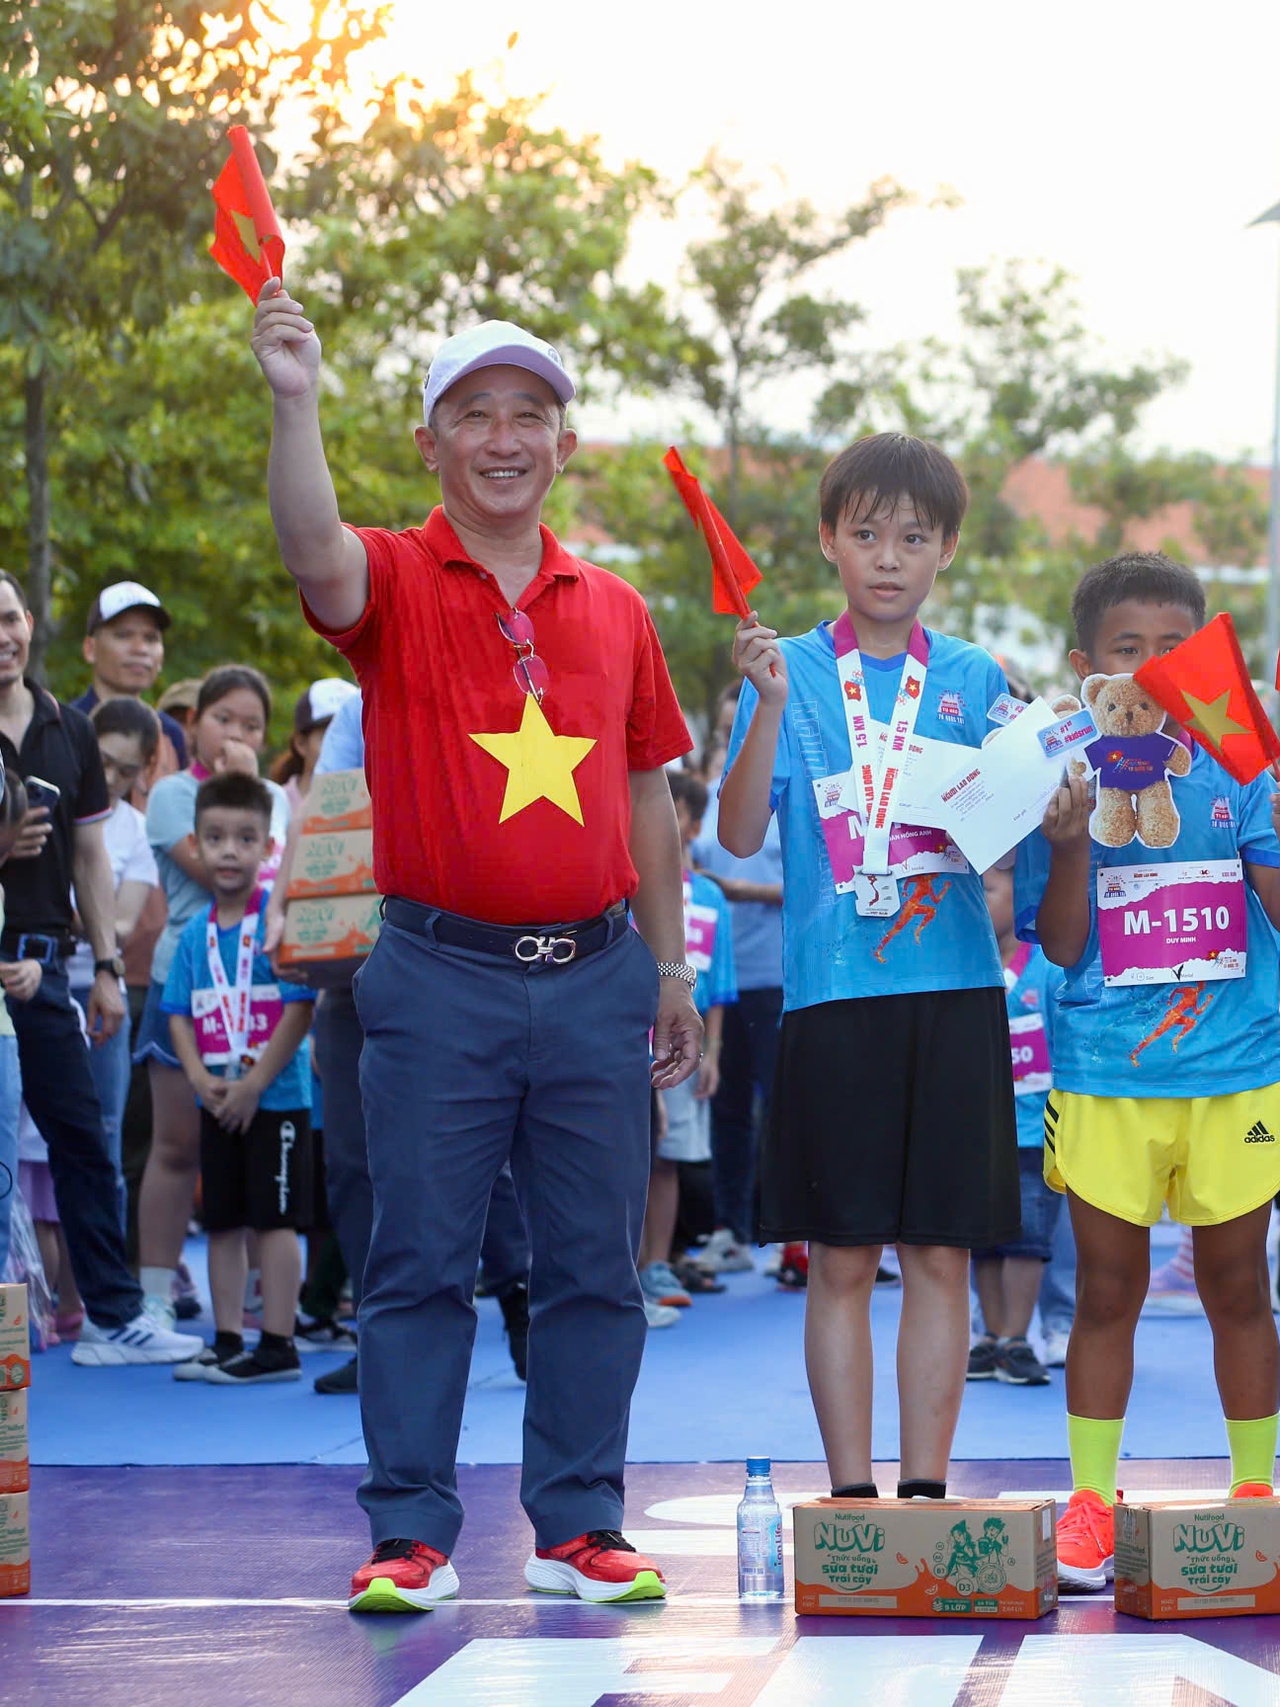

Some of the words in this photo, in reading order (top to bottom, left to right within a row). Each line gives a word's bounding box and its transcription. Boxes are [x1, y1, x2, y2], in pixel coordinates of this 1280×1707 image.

[852, 715, 865, 732] KM
[1064, 725, 1094, 744] #kidsrun
[892, 735, 905, 752] KM
[879, 792, 890, 807] LAO
[1124, 906, 1230, 936] M-1510
[1244, 1134, 1276, 1144] adidas
[274, 1120, 297, 1216] Champion
[834, 1513, 866, 1523] Nutifood
[1194, 1513, 1224, 1523] Nutifood
[958, 1582, 972, 1592] D3
